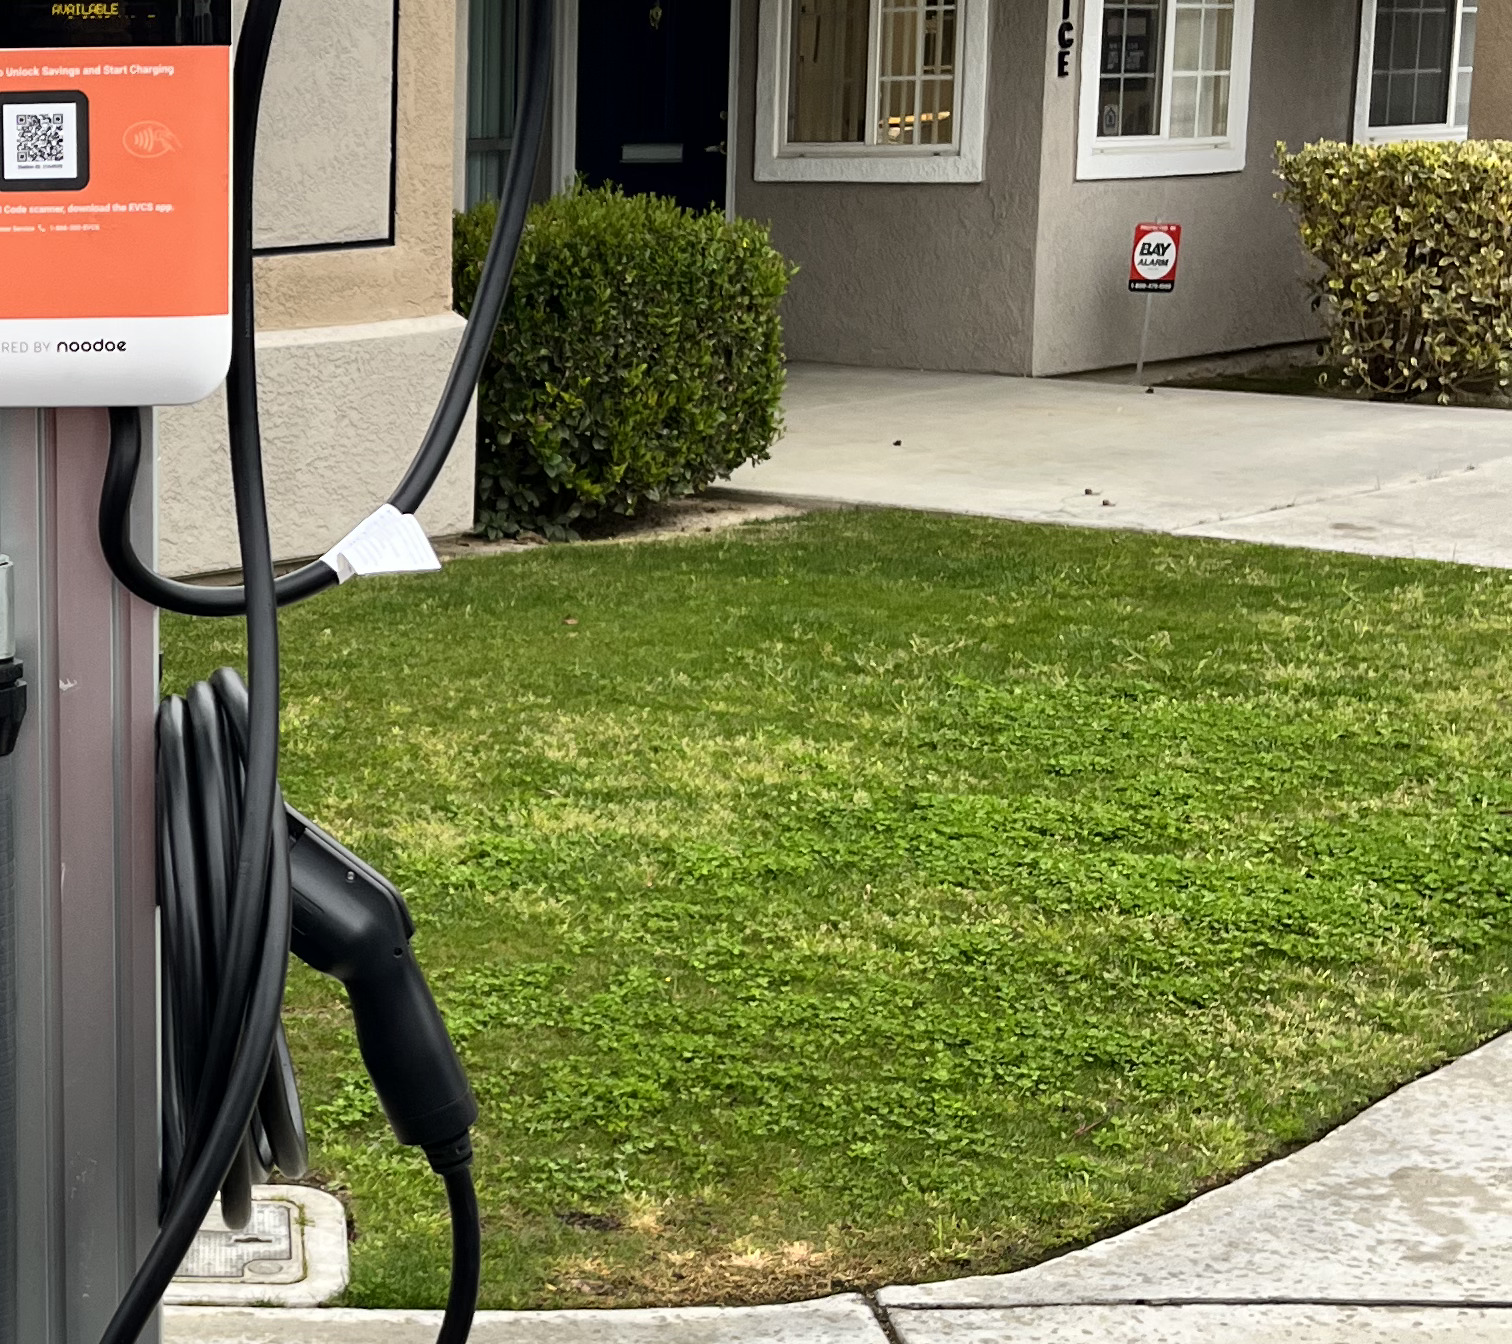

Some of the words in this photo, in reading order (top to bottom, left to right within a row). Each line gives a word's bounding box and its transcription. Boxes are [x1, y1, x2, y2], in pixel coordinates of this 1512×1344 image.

[52, 2, 119, 15] AVAILABLE
[5, 66, 39, 76] Unlock
[41, 66, 80, 77] Savings
[82, 65, 101, 75] and
[103, 64, 128, 75] Start
[129, 64, 175, 76] Charging
[3, 205, 27, 214] Code
[68, 203, 110, 213] download
[112, 203, 127, 212] the
[128, 202, 153, 212] EVCS
[1139, 242, 1172, 256] BAY
[1138, 258, 1169, 266] ALARM
[33, 341, 51, 353] BY
[56, 339, 127, 353] noodoe
